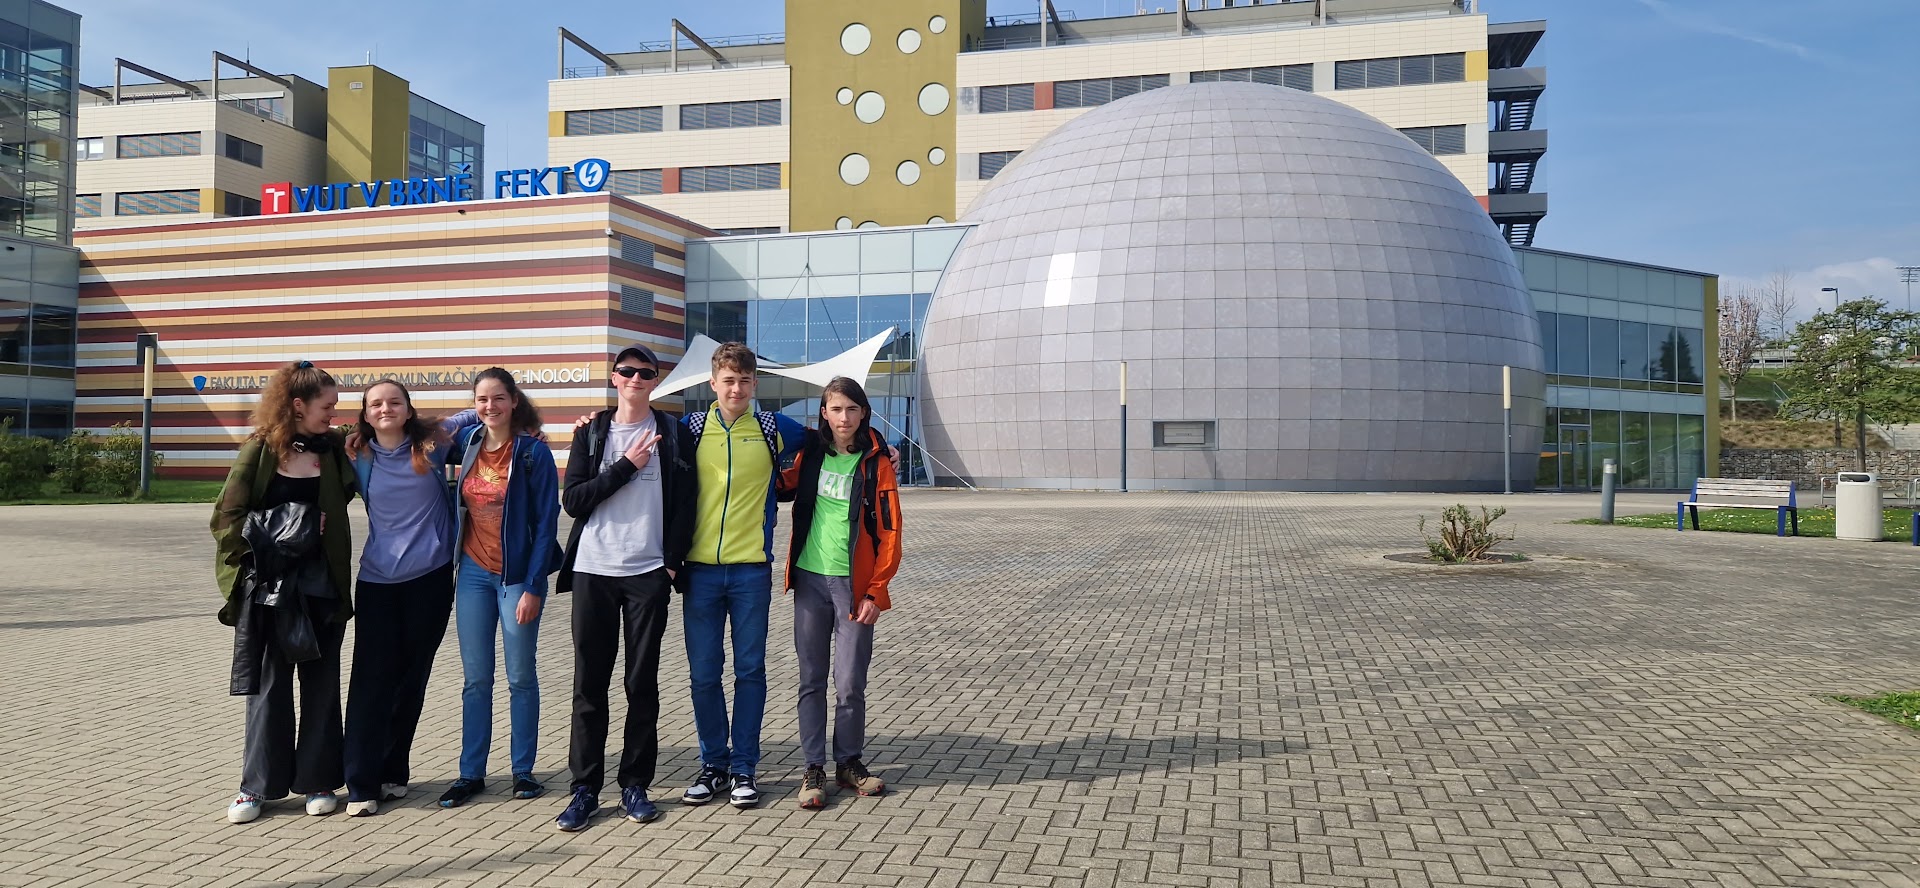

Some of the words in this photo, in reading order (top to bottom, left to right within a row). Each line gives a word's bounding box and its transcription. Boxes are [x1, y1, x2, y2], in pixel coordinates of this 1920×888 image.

[293, 183, 351, 213] VUT
[360, 179, 383, 208] V
[390, 163, 472, 206] BRNĚ
[495, 166, 571, 199] FEKT
[210, 375, 256, 390] FAKULTA
[510, 362, 591, 383] CHNOLOGIÍ
